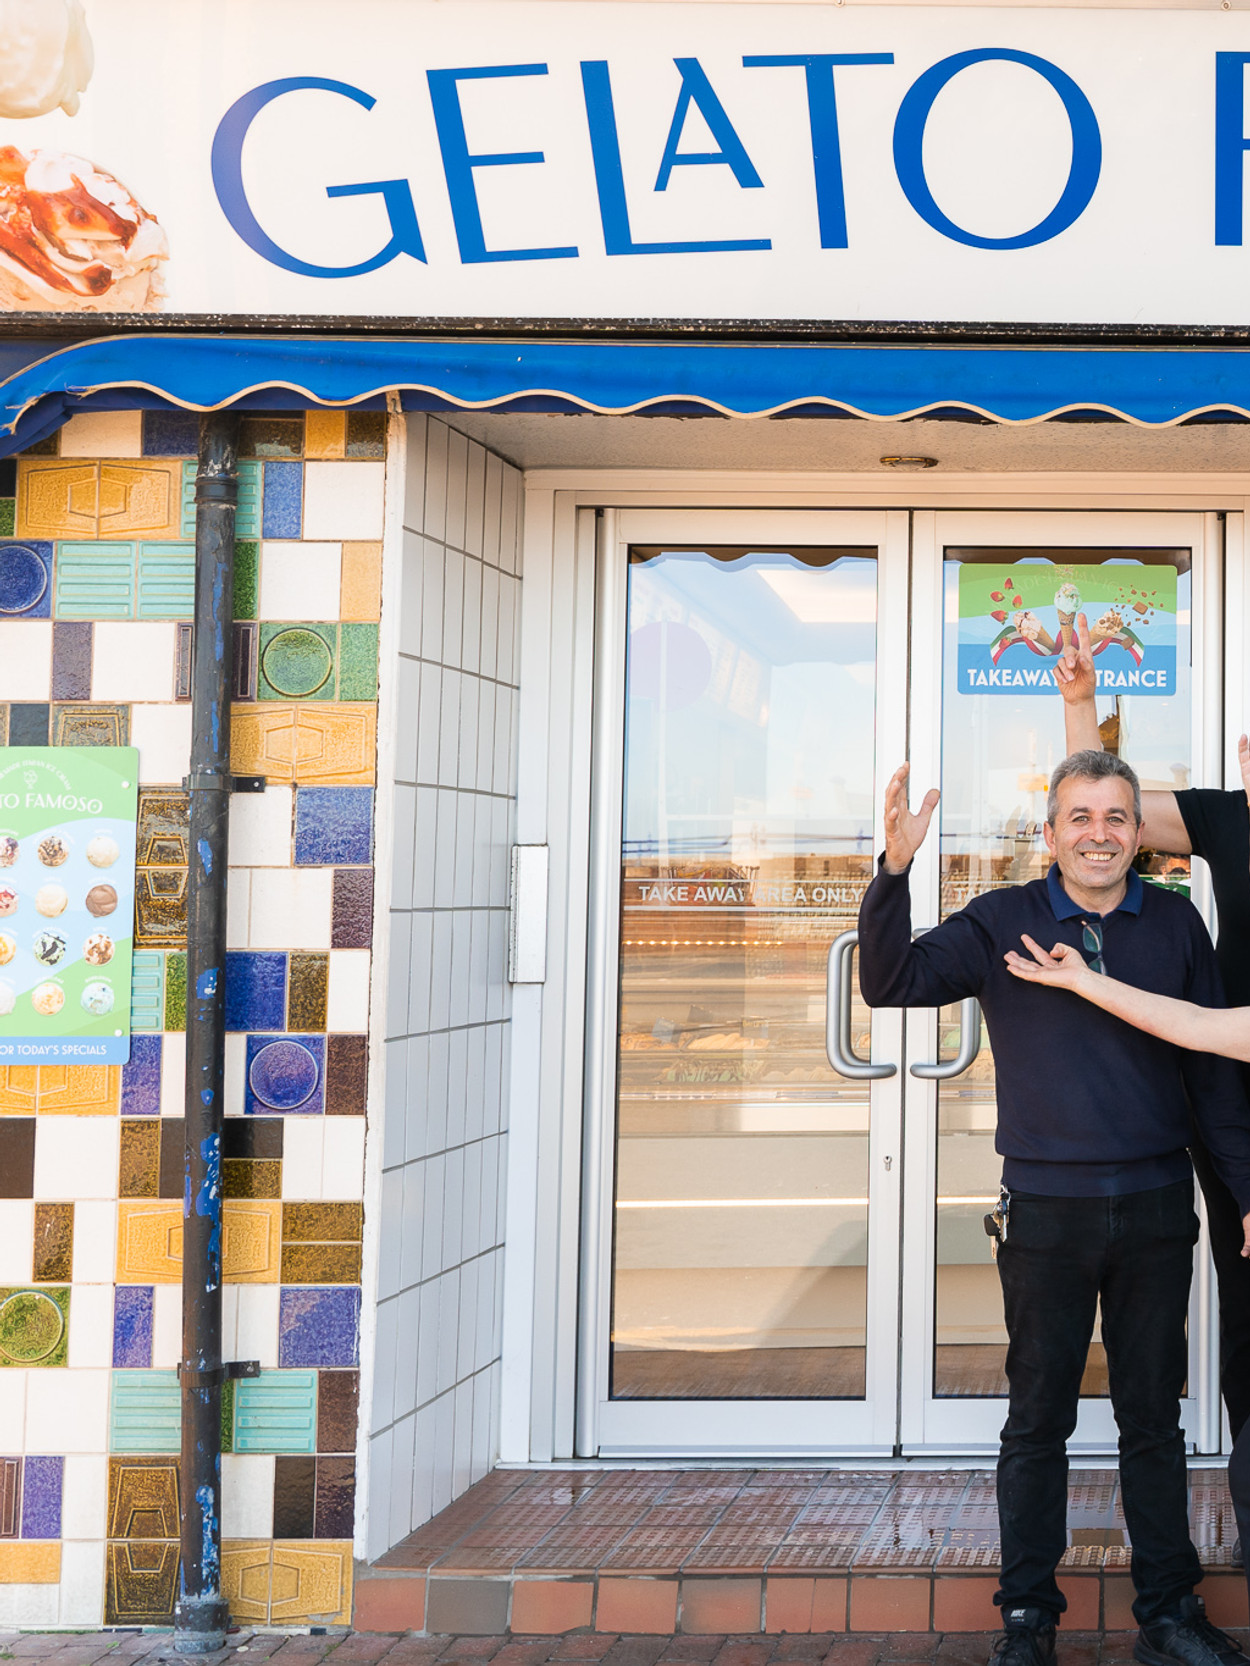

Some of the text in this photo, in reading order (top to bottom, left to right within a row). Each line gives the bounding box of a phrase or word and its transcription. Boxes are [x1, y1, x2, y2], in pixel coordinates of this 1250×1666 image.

[209, 47, 1103, 279] GELATO
[1096, 670, 1167, 688] TRANCE
[25, 793, 103, 814] FAMOSO
[638, 886, 864, 903] TAKE AWAY AREA ONLY
[0, 1045, 107, 1056] OR TODAY'S SPECIALS
